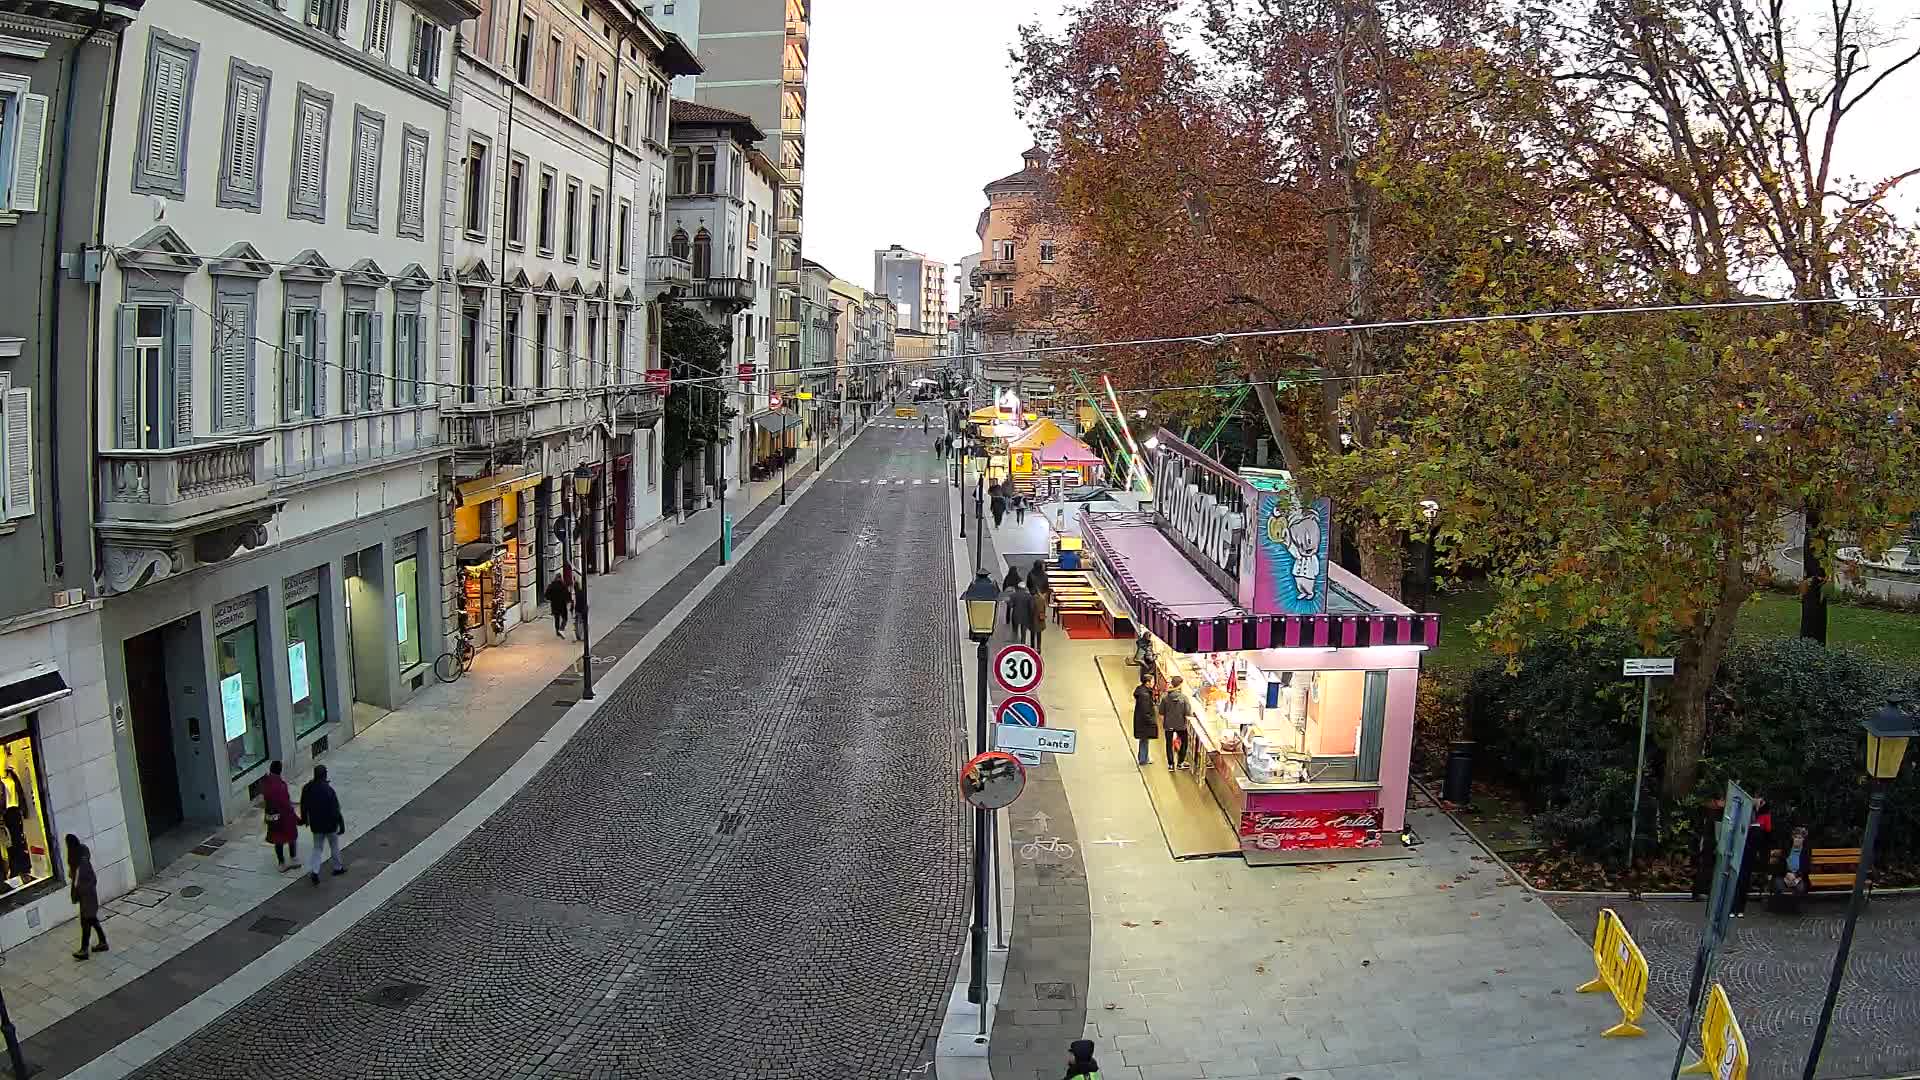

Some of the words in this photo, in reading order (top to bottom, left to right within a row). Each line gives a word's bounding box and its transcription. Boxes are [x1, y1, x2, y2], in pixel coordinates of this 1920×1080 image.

[1162, 458, 1238, 570] Golosone
[1005, 658, 1033, 680] 30
[1038, 737, 1070, 749] Dante
